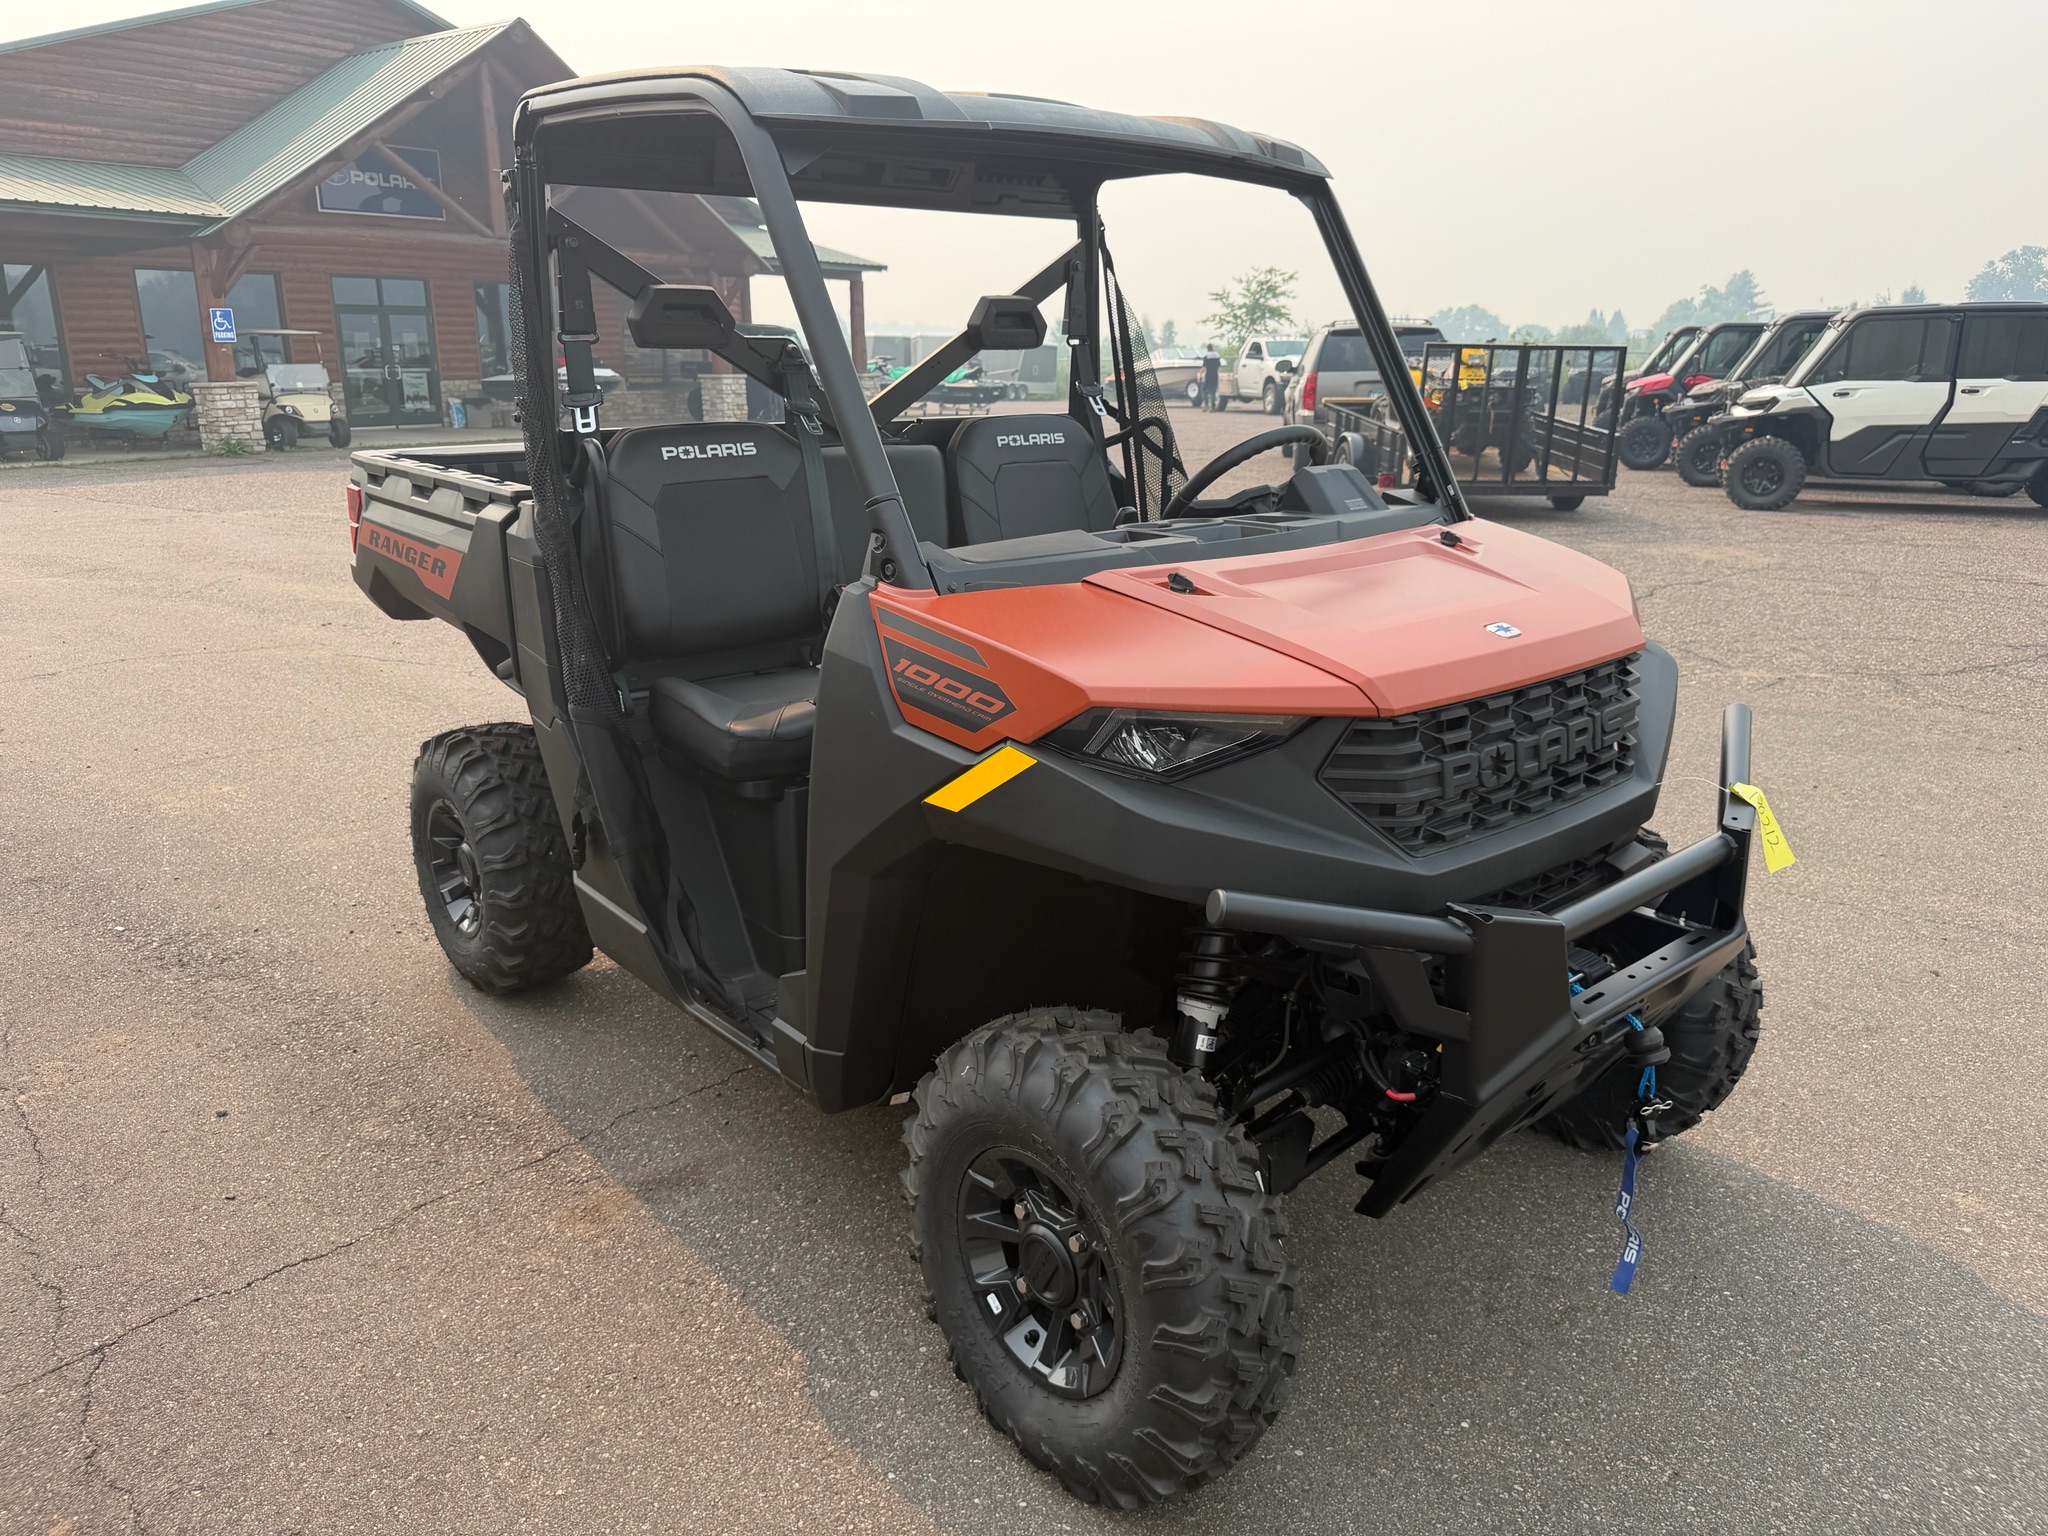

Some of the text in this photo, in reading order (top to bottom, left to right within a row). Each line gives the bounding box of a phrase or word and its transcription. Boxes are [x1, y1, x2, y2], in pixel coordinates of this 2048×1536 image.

[349, 170, 433, 190] POLAR
[214, 331, 235, 339] PARKING
[661, 442, 757, 460] POLARIS
[996, 432, 1065, 448] POLARIS
[368, 529, 447, 578] RANGER
[893, 657, 1006, 714] 1000
[896, 677, 992, 722] SINGLE OVERHEAD CAM
[1441, 702, 1628, 800] POLARIS
[1615, 1190, 1640, 1265] PORIS
